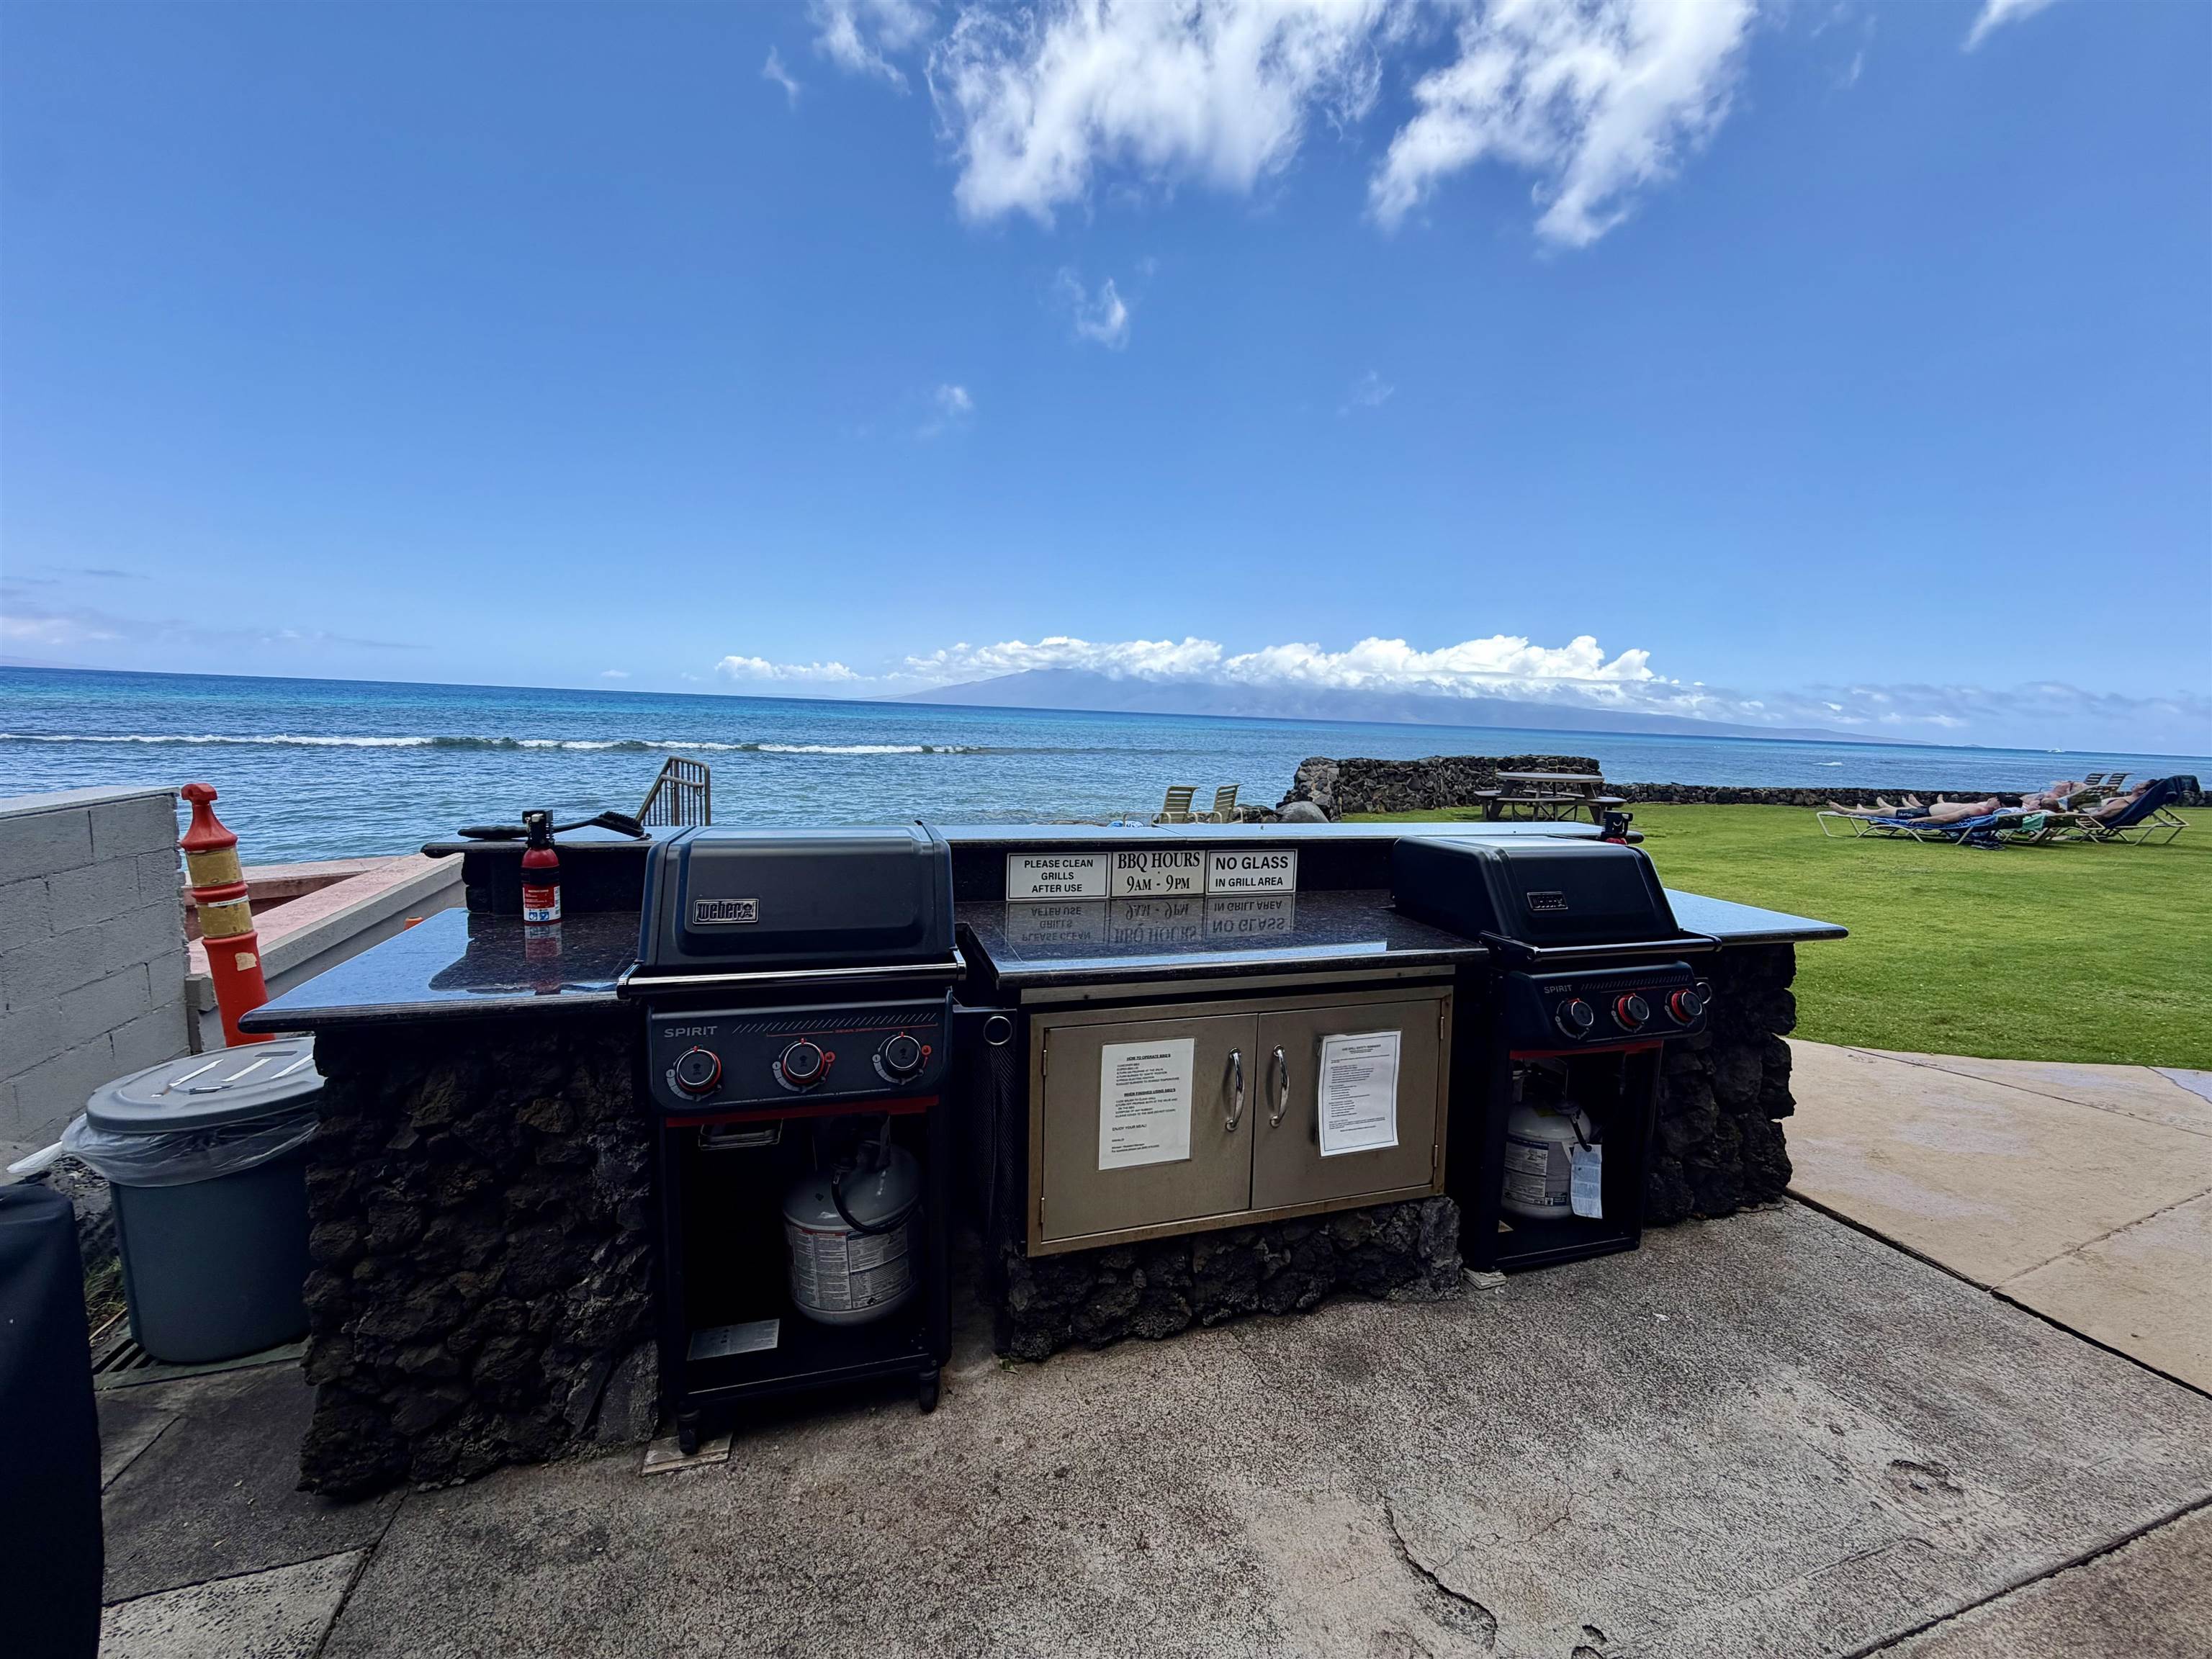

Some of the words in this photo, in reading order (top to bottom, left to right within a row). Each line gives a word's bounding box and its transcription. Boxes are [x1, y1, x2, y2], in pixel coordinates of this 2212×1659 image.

[1024, 860, 1060, 868] PLEASE
[1062, 859, 1094, 868] CLEAN
[1117, 853, 1147, 872] BBQ
[1151, 852, 1200, 868] HOURS
[1215, 857, 1237, 870] NO
[1241, 856, 1289, 869] GLASS
[1041, 872, 1074, 881] GRILLS
[1215, 878, 1225, 887] IN
[1228, 878, 1256, 887] GRILL
[1257, 877, 1283, 886] AREA
[1126, 876, 1151, 893] 9AM
[1166, 875, 1190, 891] 9PM
[1544, 984, 1573, 994] SPIRIT
[664, 1026, 718, 1038] SPIRIT
